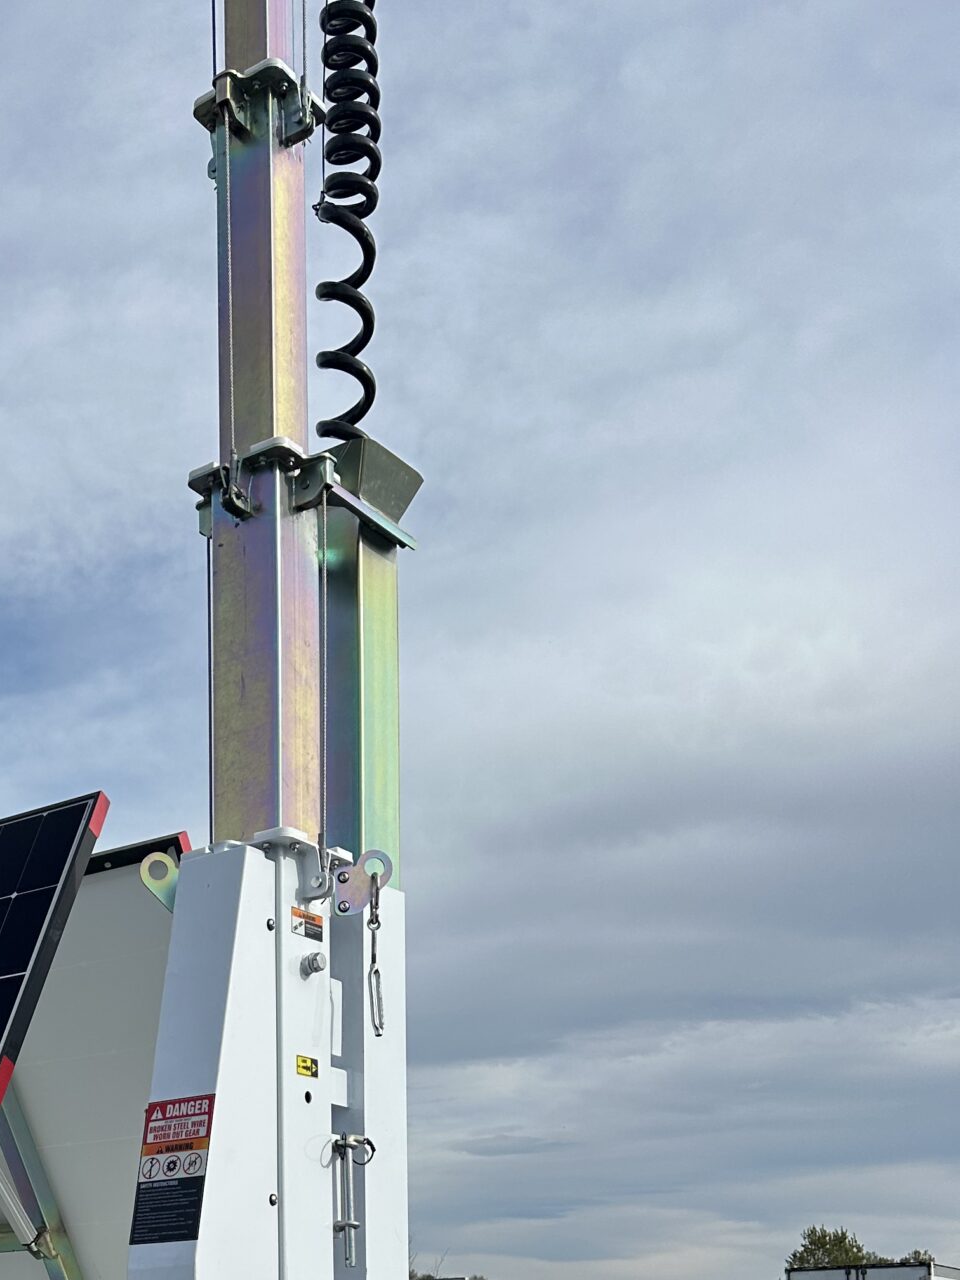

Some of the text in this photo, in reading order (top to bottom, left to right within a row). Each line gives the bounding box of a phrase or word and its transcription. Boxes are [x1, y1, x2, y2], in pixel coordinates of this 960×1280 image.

[166, 1100, 209, 1118] DANGER
[149, 1123, 173, 1134] BROKEN
[173, 1121, 190, 1131] STEEL
[191, 1119, 206, 1129] WIRE
[153, 1129, 200, 1141] WORN OUT GEAR
[165, 1142, 193, 1152] WARNING
